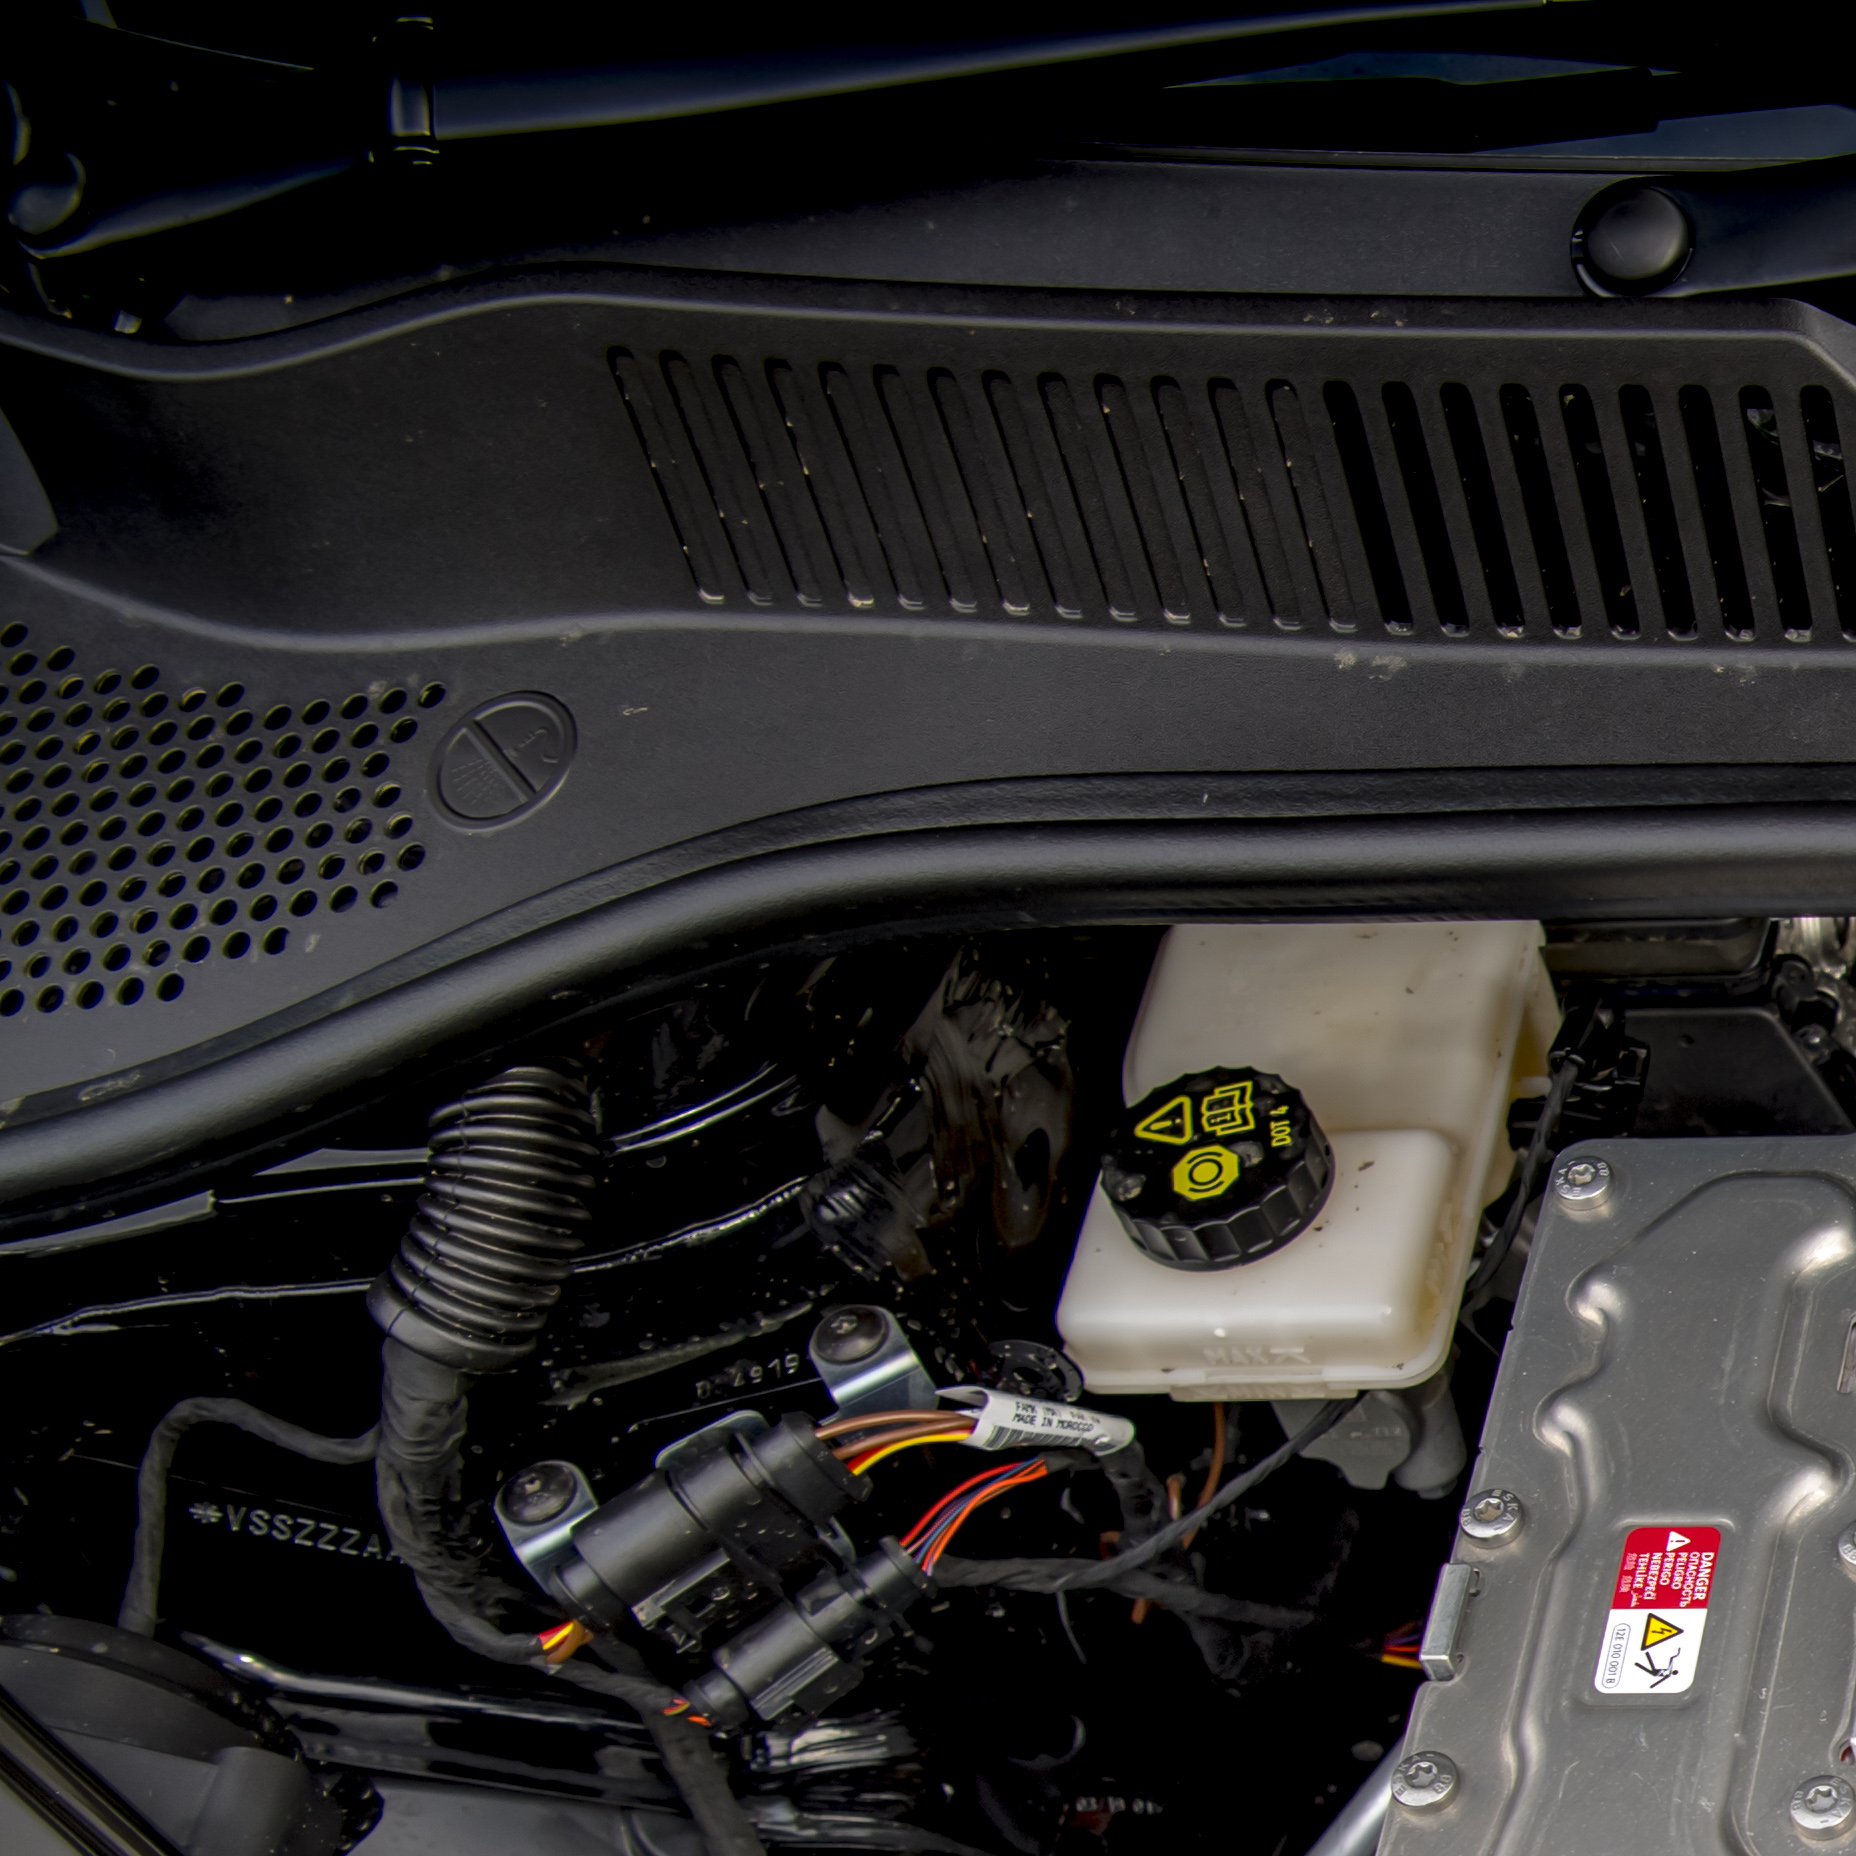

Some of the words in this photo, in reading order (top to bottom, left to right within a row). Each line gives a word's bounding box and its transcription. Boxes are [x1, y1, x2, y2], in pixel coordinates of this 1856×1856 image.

[1270, 1120, 1292, 1147] DOT
[1012, 1413, 1036, 1426] MADE
[1041, 1417, 1053, 1427] IN
[1056, 1419, 1095, 1433] MOROCCO
[1659, 1551, 1676, 1586] PERIGO
[1671, 1551, 1689, 1590] PELIGRO
[1692, 1551, 1715, 1601] DANGER
[1611, 1643, 1623, 1659] 010
[1608, 1660, 1619, 1676] 001
